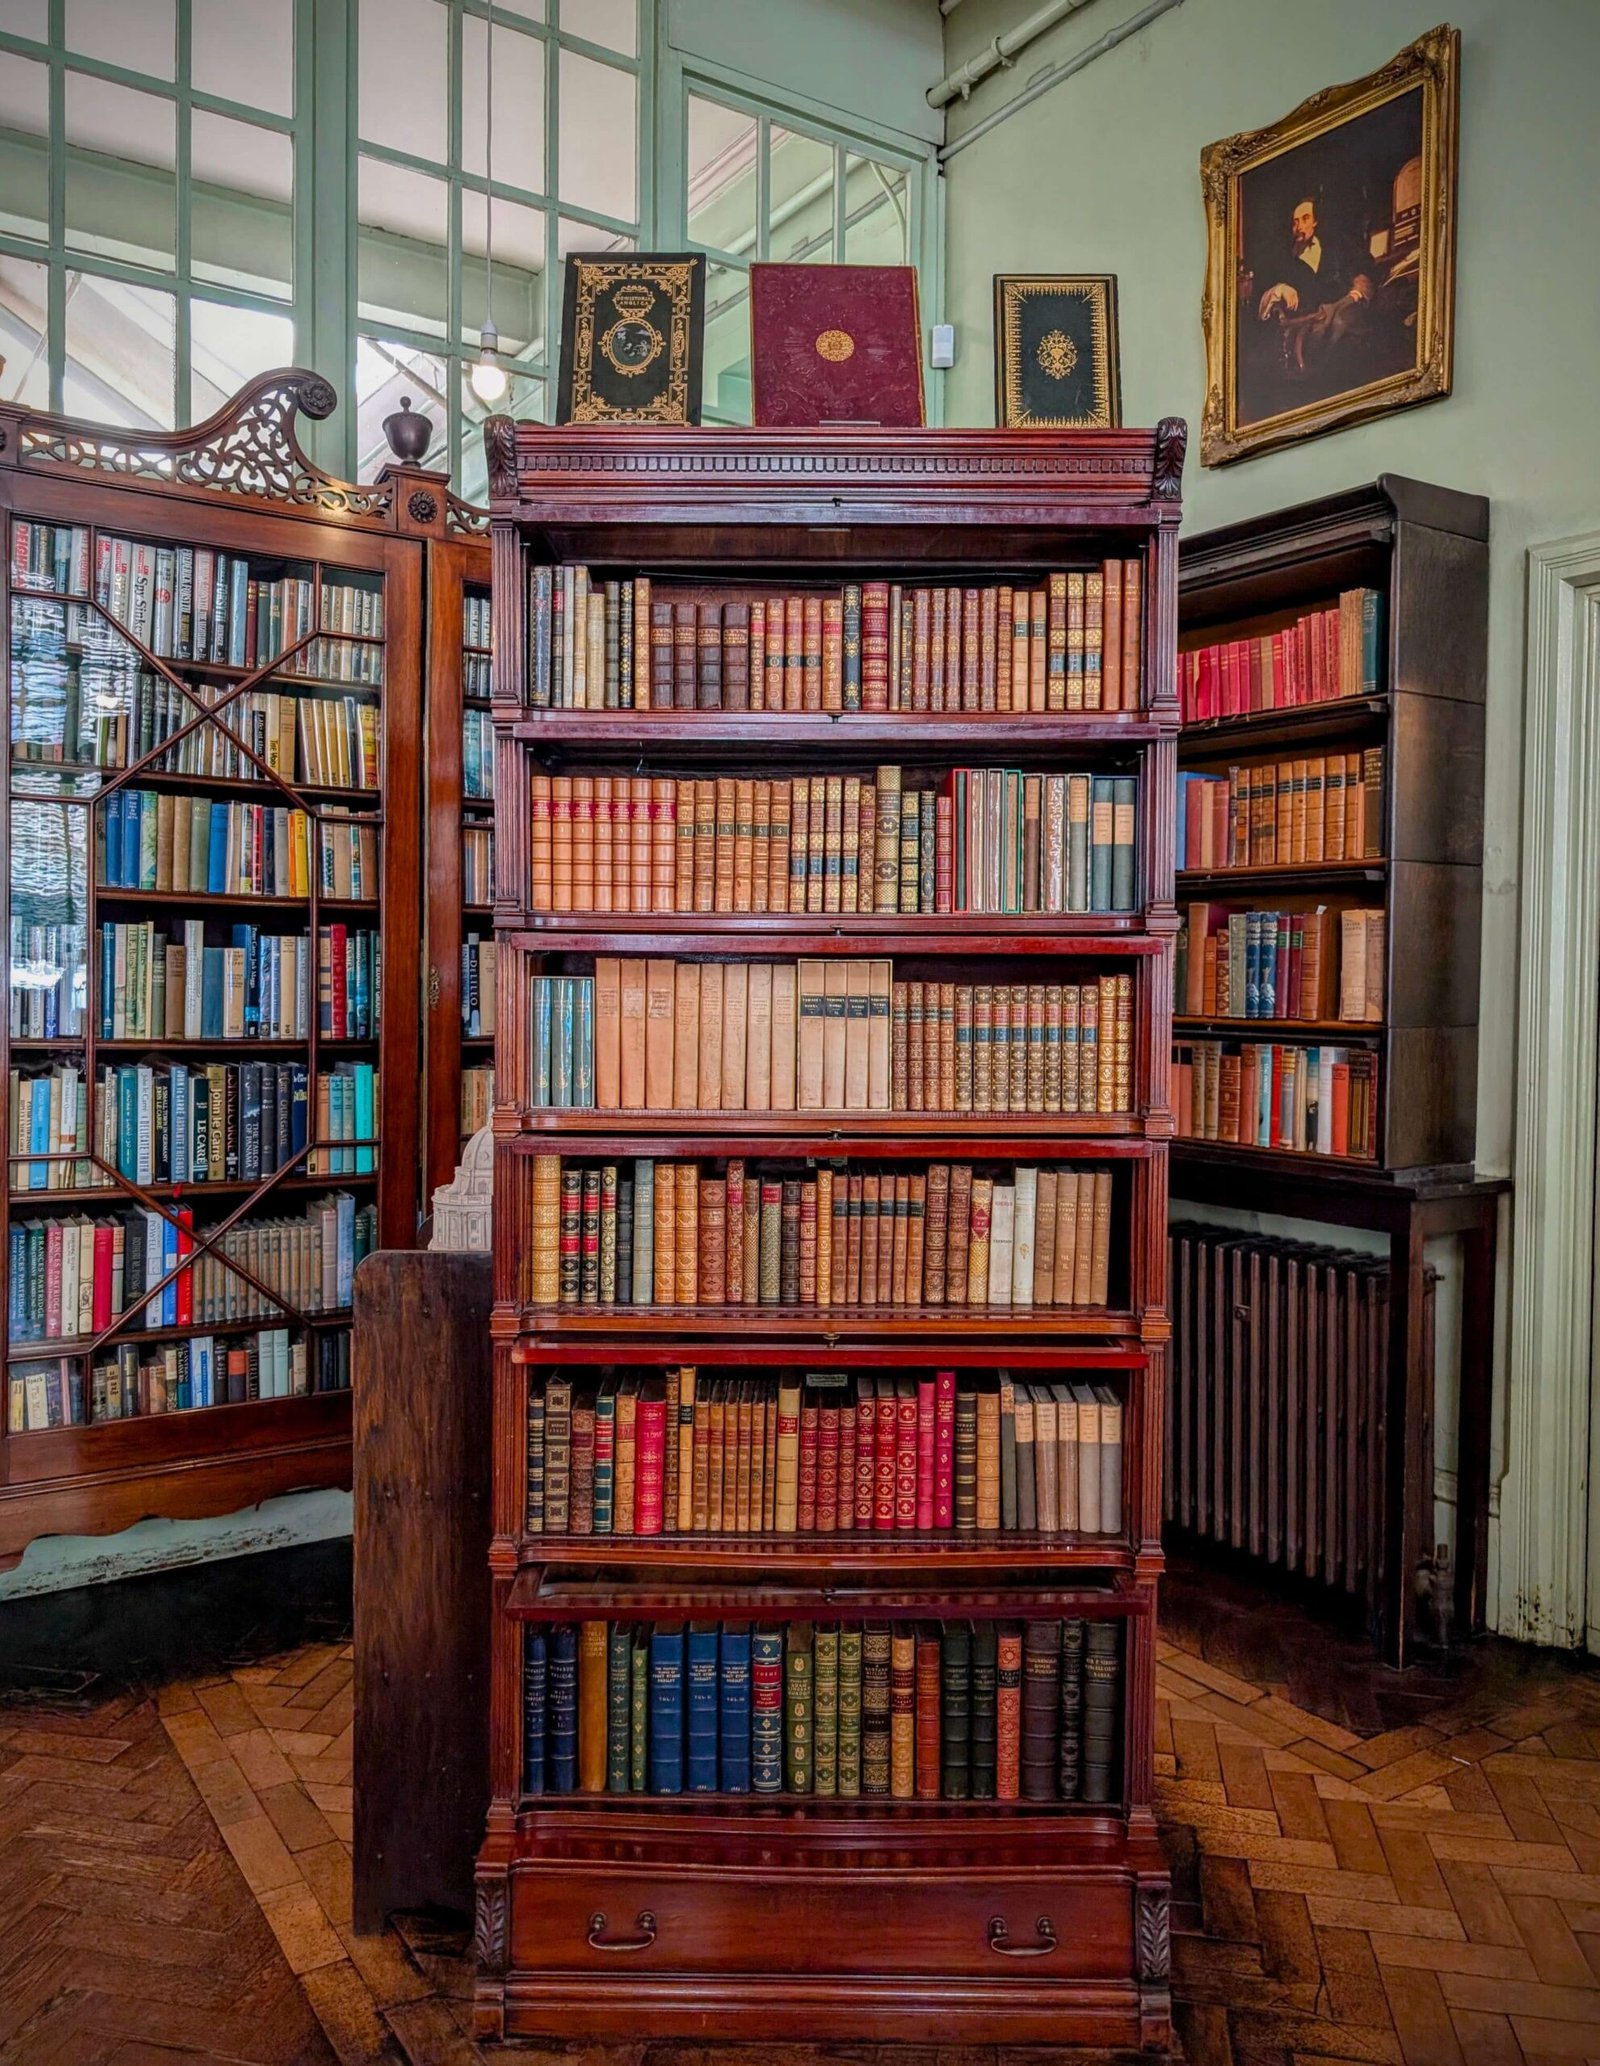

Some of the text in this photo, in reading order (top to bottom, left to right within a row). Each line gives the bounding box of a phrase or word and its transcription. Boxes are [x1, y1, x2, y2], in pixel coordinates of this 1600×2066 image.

[181, 549, 192, 583] FREDERICK
[198, 553, 209, 582] FREDERICK
[134, 577, 148, 637] Spy Sinker
[181, 585, 191, 613] FORSYTH
[198, 584, 208, 610] FORSYTH
[216, 583, 227, 622] FORSYTH
[197, 621, 206, 648] NEGOTIATOR
[258, 731, 264, 739] at
[270, 740, 278, 751] THE
[141, 1073, 149, 1088] John
[177, 1070, 186, 1086] JOHN
[141, 1094, 149, 1111] Carré
[177, 1095, 187, 1114] CARRÉ
[228, 1073, 236, 1114] JOHN LE
[139, 1120, 149, 1150] DELICATE
[176, 1116, 185, 1145] ABSOLUTE
[210, 1088, 224, 1162] John le Carré
[246, 1124, 252, 1134] OF
[197, 1120, 208, 1164] LE CARRÉ
[139, 1152, 149, 1172] TRUTH
[175, 1146, 184, 1174] FRIENDS
[132, 1237, 141, 1260] ROBERT
